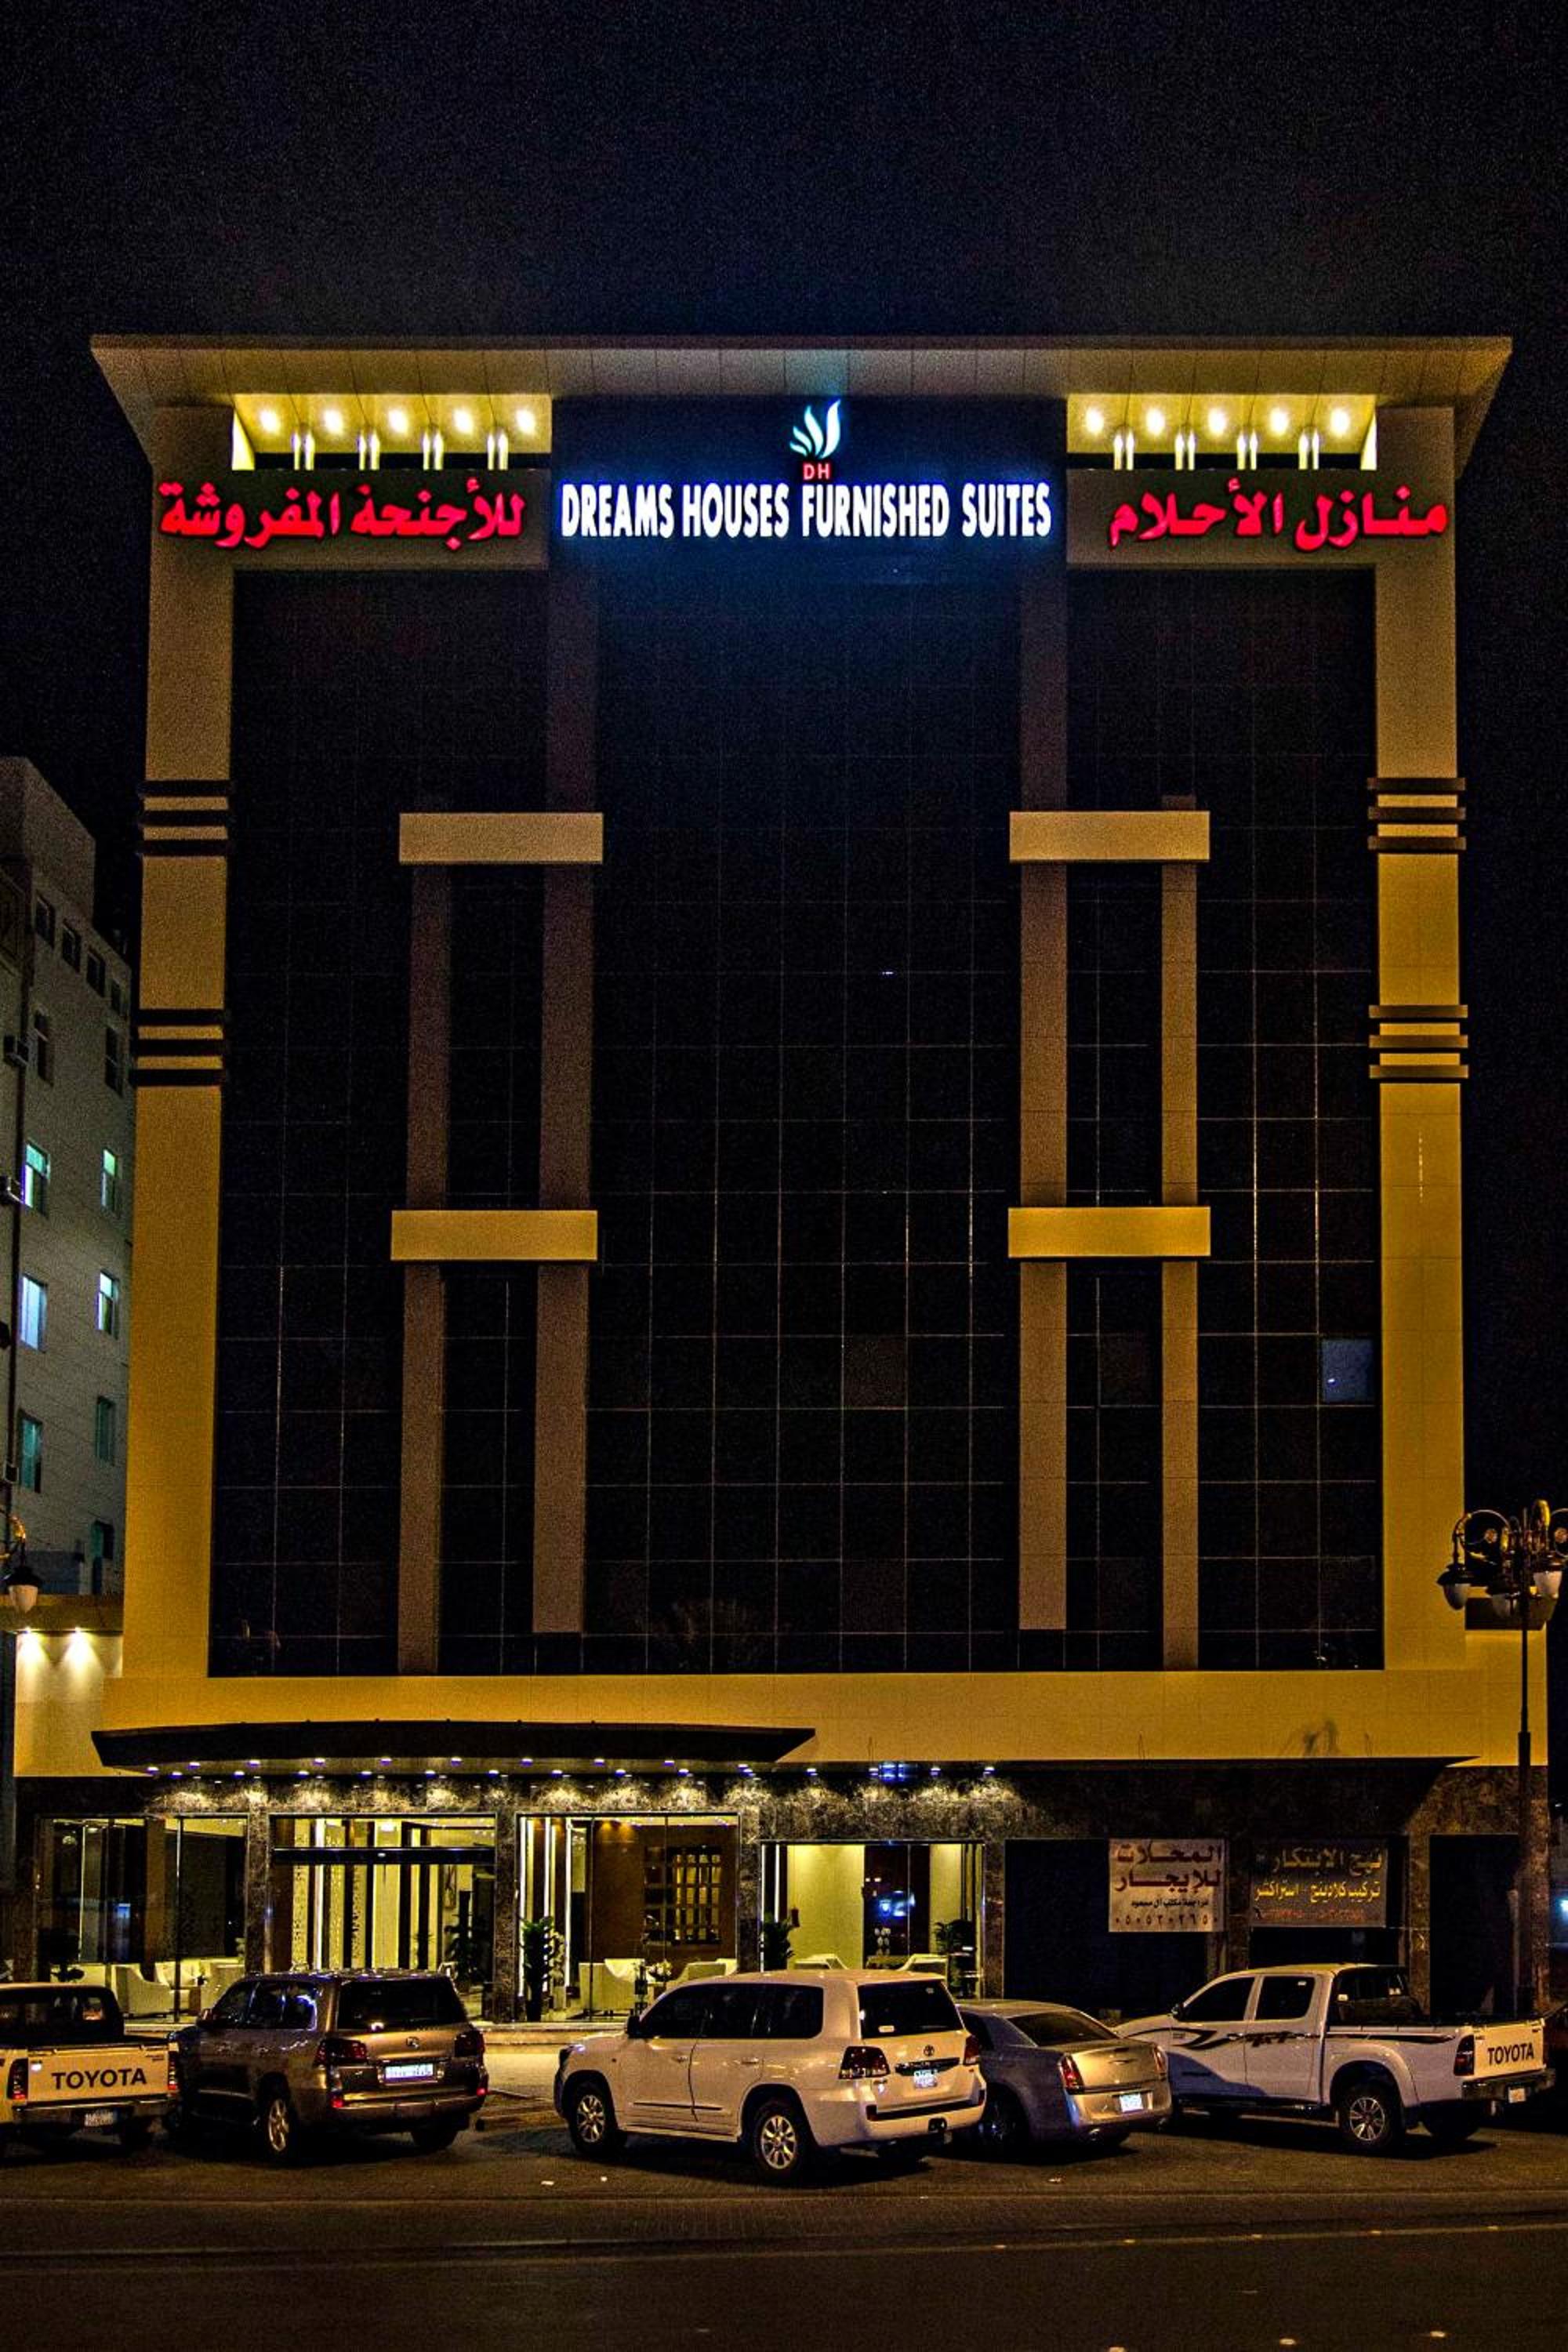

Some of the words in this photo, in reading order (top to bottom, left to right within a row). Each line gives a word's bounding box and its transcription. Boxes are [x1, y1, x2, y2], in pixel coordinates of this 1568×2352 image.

[803, 463, 830, 481] DH
[158, 482, 340, 548] المفروشة
[350, 477, 524, 550] للأجنحة
[561, 482, 675, 539] DREAMS
[682, 482, 789, 539] HOUSES
[802, 482, 949, 539] FURNISHED
[962, 482, 1051, 539] SUITES
[1109, 477, 1284, 547] الأحلام
[1295, 485, 1449, 551] منازل
[1117, 1840, 1221, 1864] المحلات
[1115, 1869, 1221, 1893] للإيجار
[1348, 1879, 1381, 1903] تركيب
[1487, 2042, 1535, 2066] TOYOTA
[51, 2068, 147, 2089] TOYOTA
